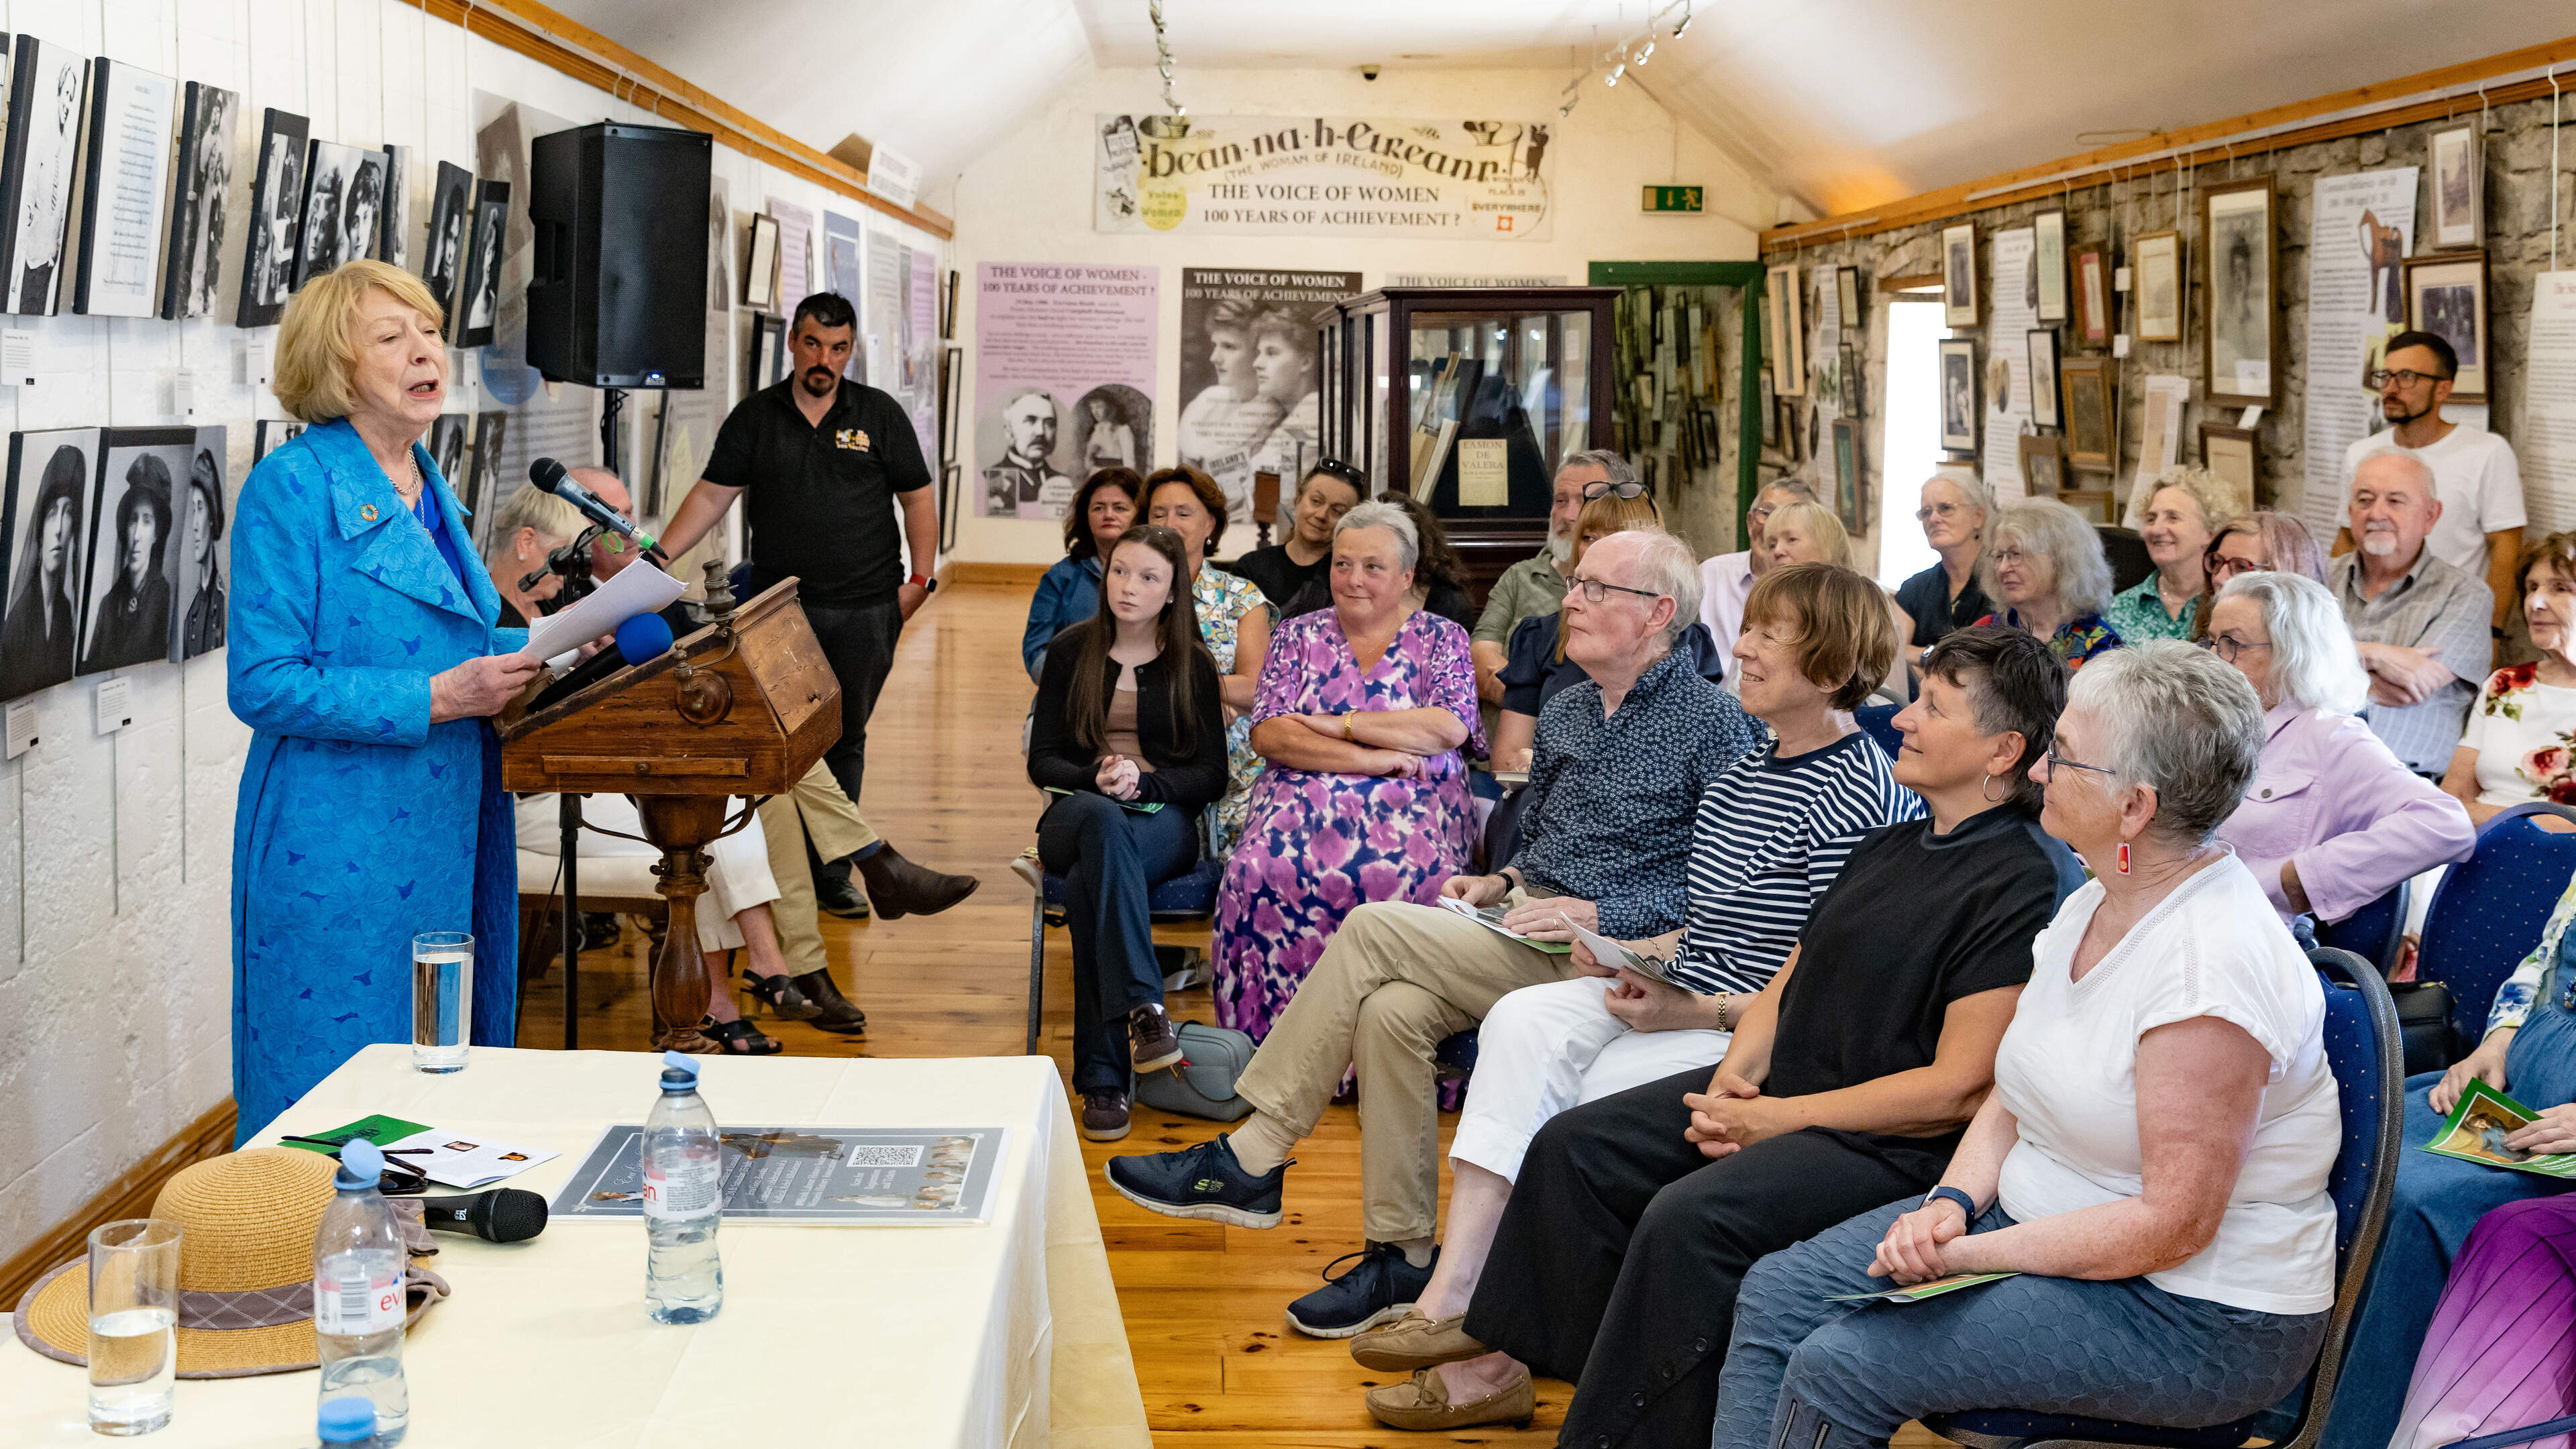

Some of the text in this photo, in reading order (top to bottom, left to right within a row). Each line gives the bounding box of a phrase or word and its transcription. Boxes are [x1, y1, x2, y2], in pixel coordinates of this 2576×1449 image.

[1260, 155, 1309, 172] WOMAN
[1315, 154, 1329, 163] OF
[1208, 182, 1442, 203] THE VOICE OF WOMEN
[1203, 209, 1228, 223] 100
[1233, 209, 1288, 224] YEARS
[1293, 211, 1316, 224] OF
[1320, 211, 1450, 227] ACHIEVEMENT
[990, 266, 1018, 279] THE
[1020, 267, 1063, 280] VOICE
[1065, 268, 1083, 280] OF
[1085, 269, 1140, 281] WOMEN
[1193, 271, 1346, 288] THE VOICE OF WOMEN
[1397, 276, 1422, 287] THE
[1428, 277, 1468, 287] VOICE
[983, 282, 1001, 292] 100
[1004, 282, 1039, 293] YEARS
[1042, 283, 1058, 294] OF
[1061, 284, 1147, 297] ACHIEVEMENT
[1185, 288, 1349, 303] 100 YEARS OF ACHIEVEMENT
[1477, 451, 1490, 459] DE
[1462, 461, 1504, 469] VALERA
